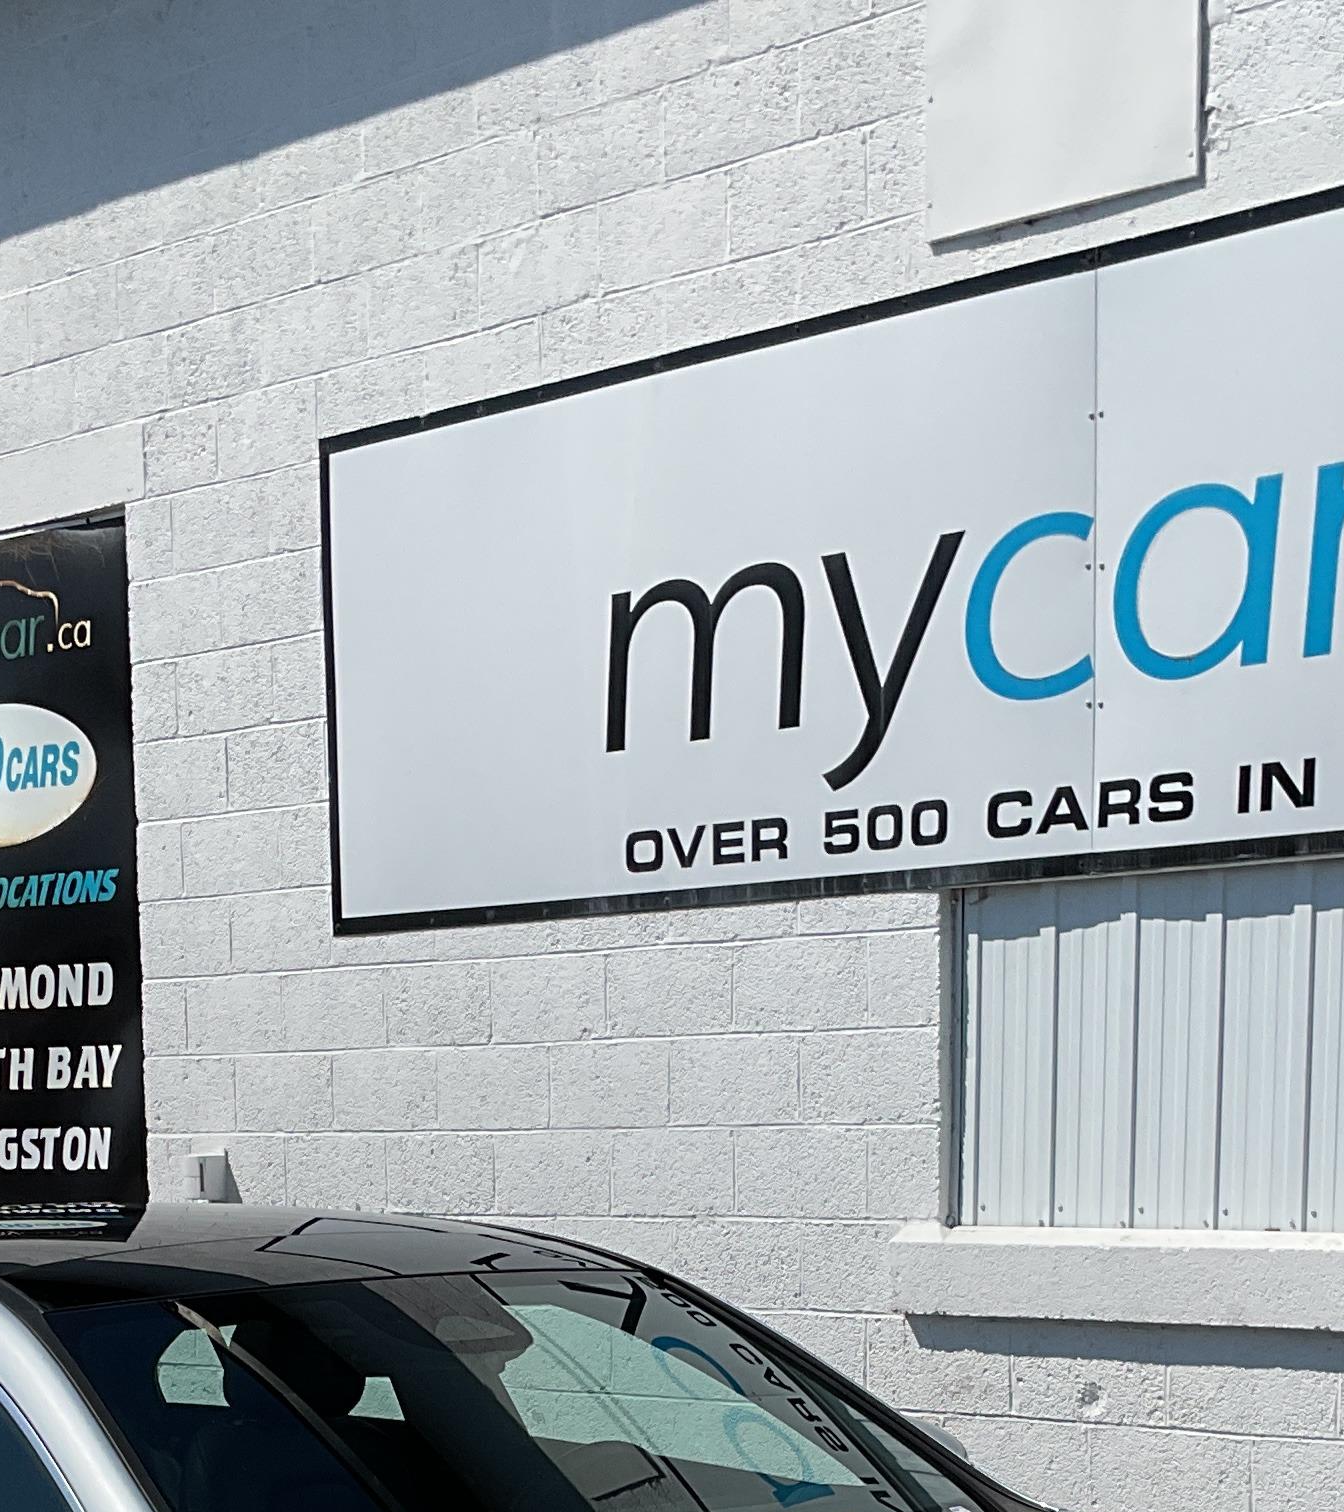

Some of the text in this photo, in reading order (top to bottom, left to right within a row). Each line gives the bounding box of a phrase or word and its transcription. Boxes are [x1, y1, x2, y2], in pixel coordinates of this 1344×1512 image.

[624, 821, 790, 874] OVER
[821, 802, 948, 855] 500
[986, 772, 1194, 841] CARS
[1238, 757, 1316, 815] IN
[46, 1044, 122, 1090] BAY
